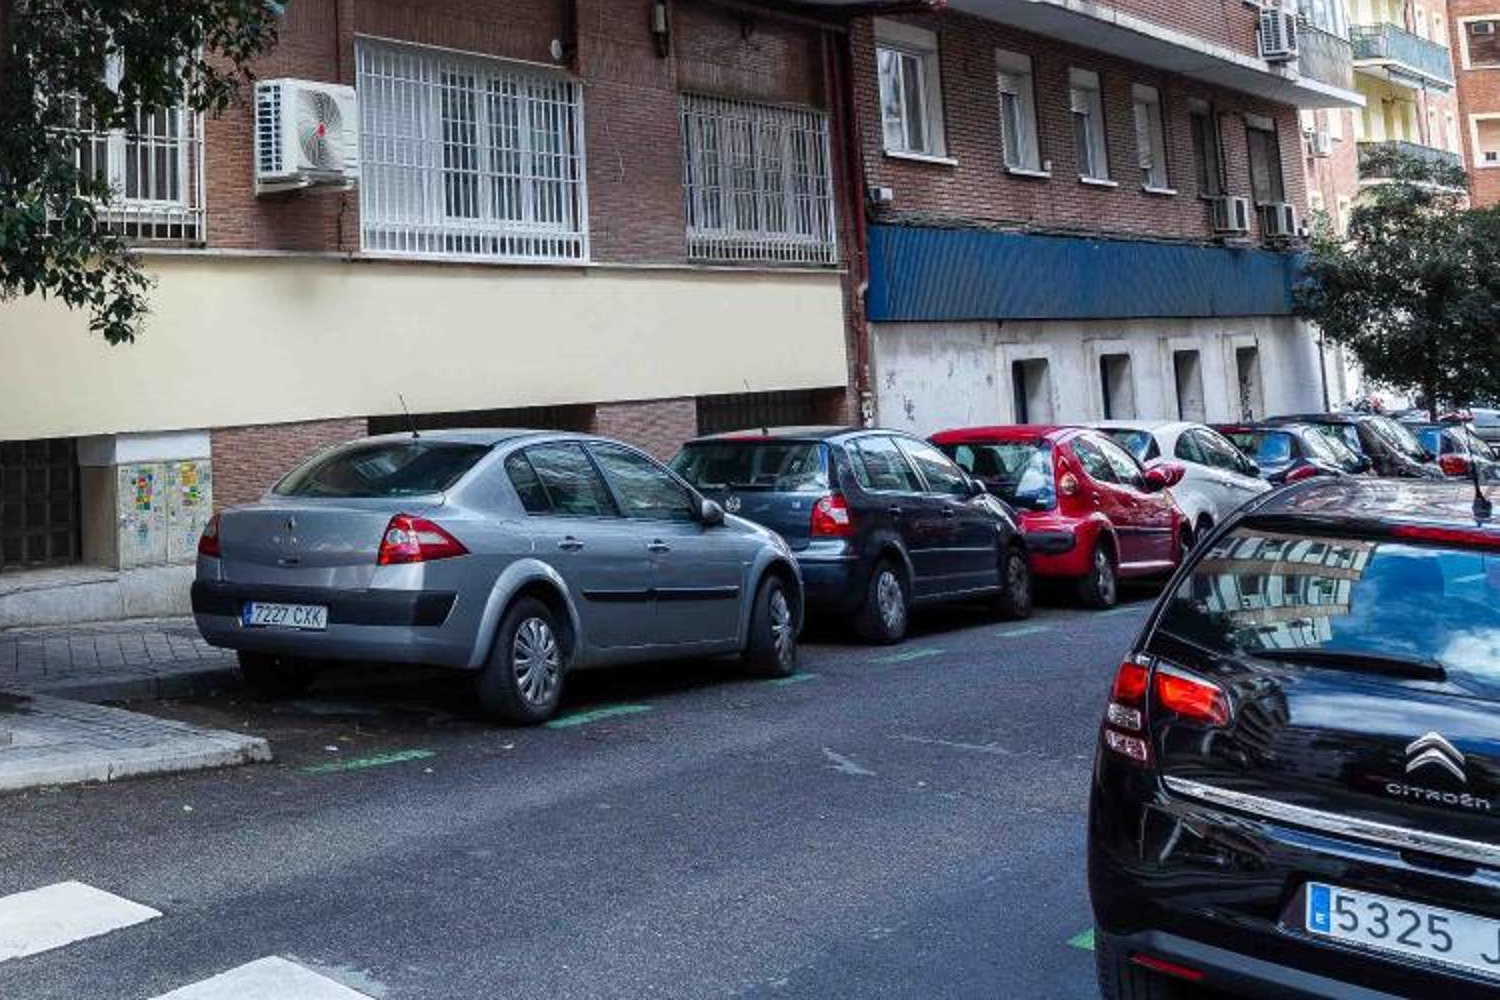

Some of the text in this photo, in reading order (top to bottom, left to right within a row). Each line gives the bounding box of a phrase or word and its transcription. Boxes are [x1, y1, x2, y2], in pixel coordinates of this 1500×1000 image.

[255, 605, 321, 626] 7227 CXK
[1334, 895, 1453, 952] 5325
